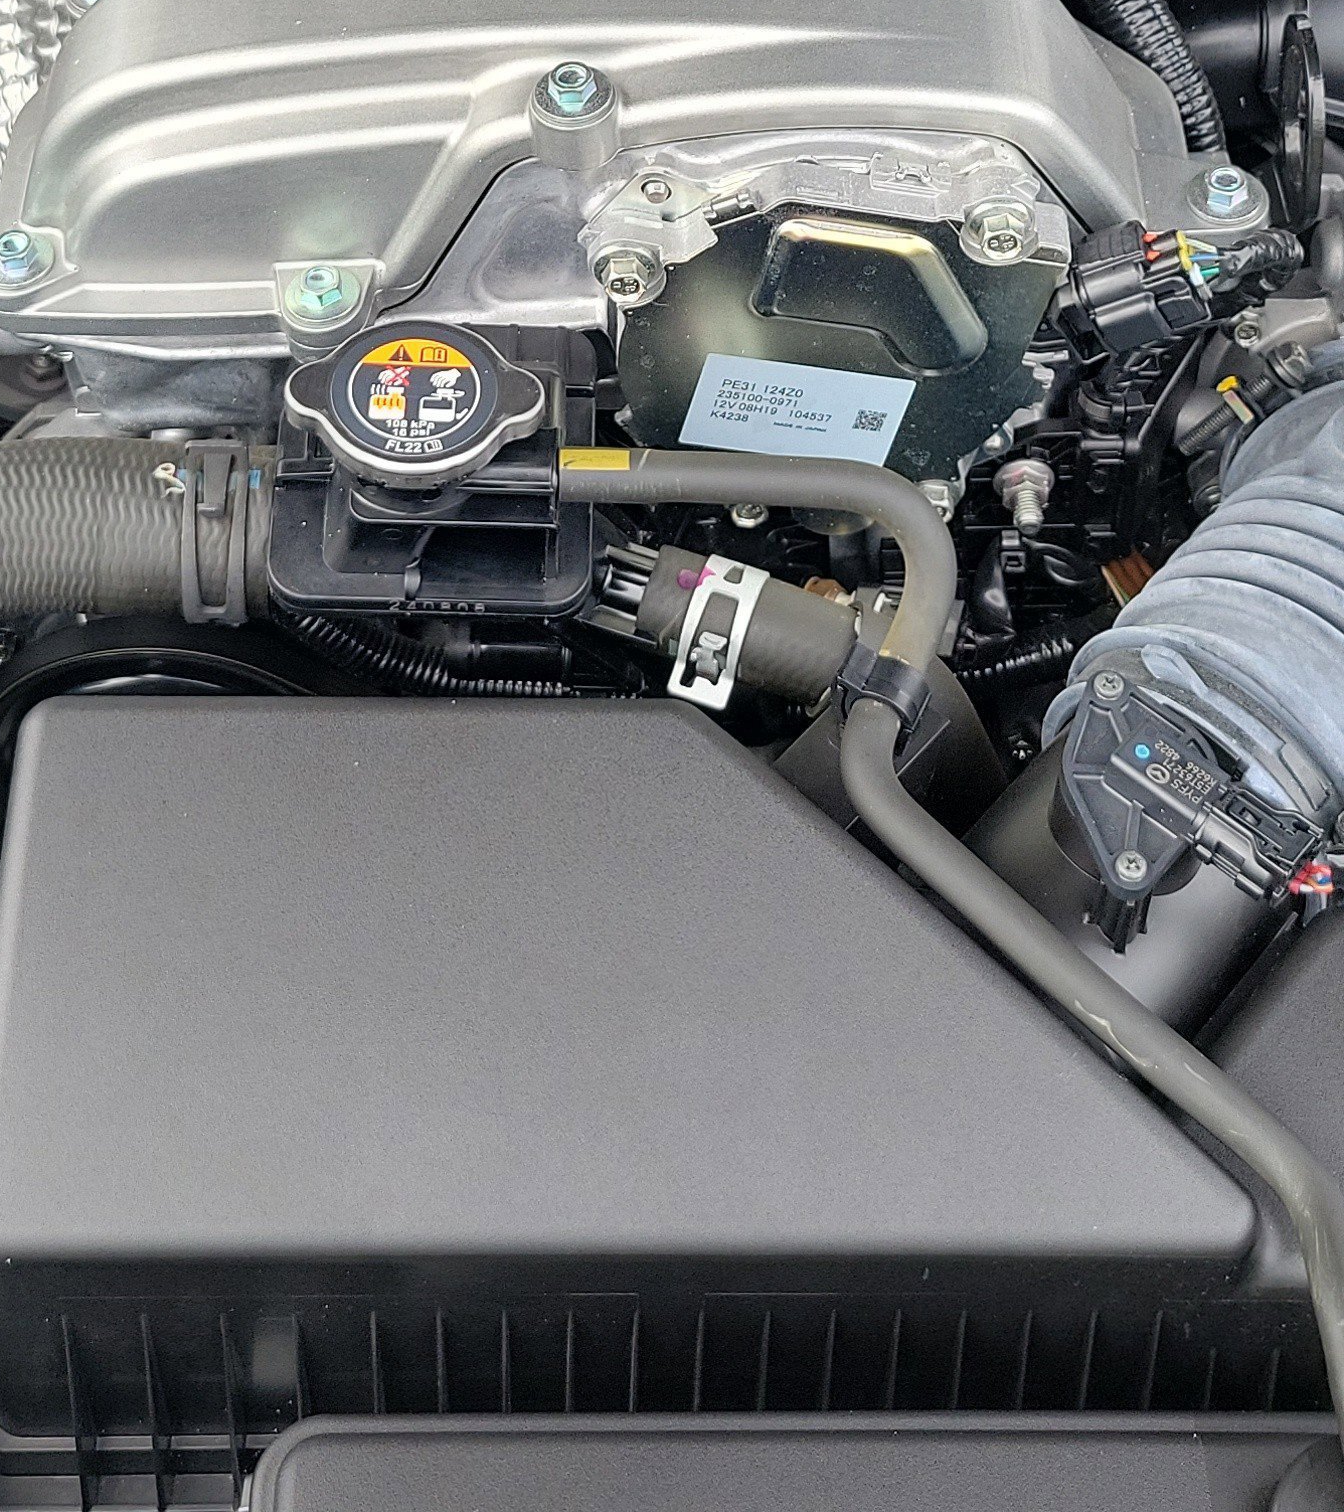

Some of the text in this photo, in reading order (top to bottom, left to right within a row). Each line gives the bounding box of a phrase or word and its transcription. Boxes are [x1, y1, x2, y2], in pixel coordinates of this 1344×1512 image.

[721, 378, 756, 391] PE31
[716, 389, 798, 407] 235100-0971
[710, 410, 749, 422] K4238
[713, 399, 737, 410] 12V
[789, 410, 833, 423] 104537
[385, 440, 423, 453] FL22
